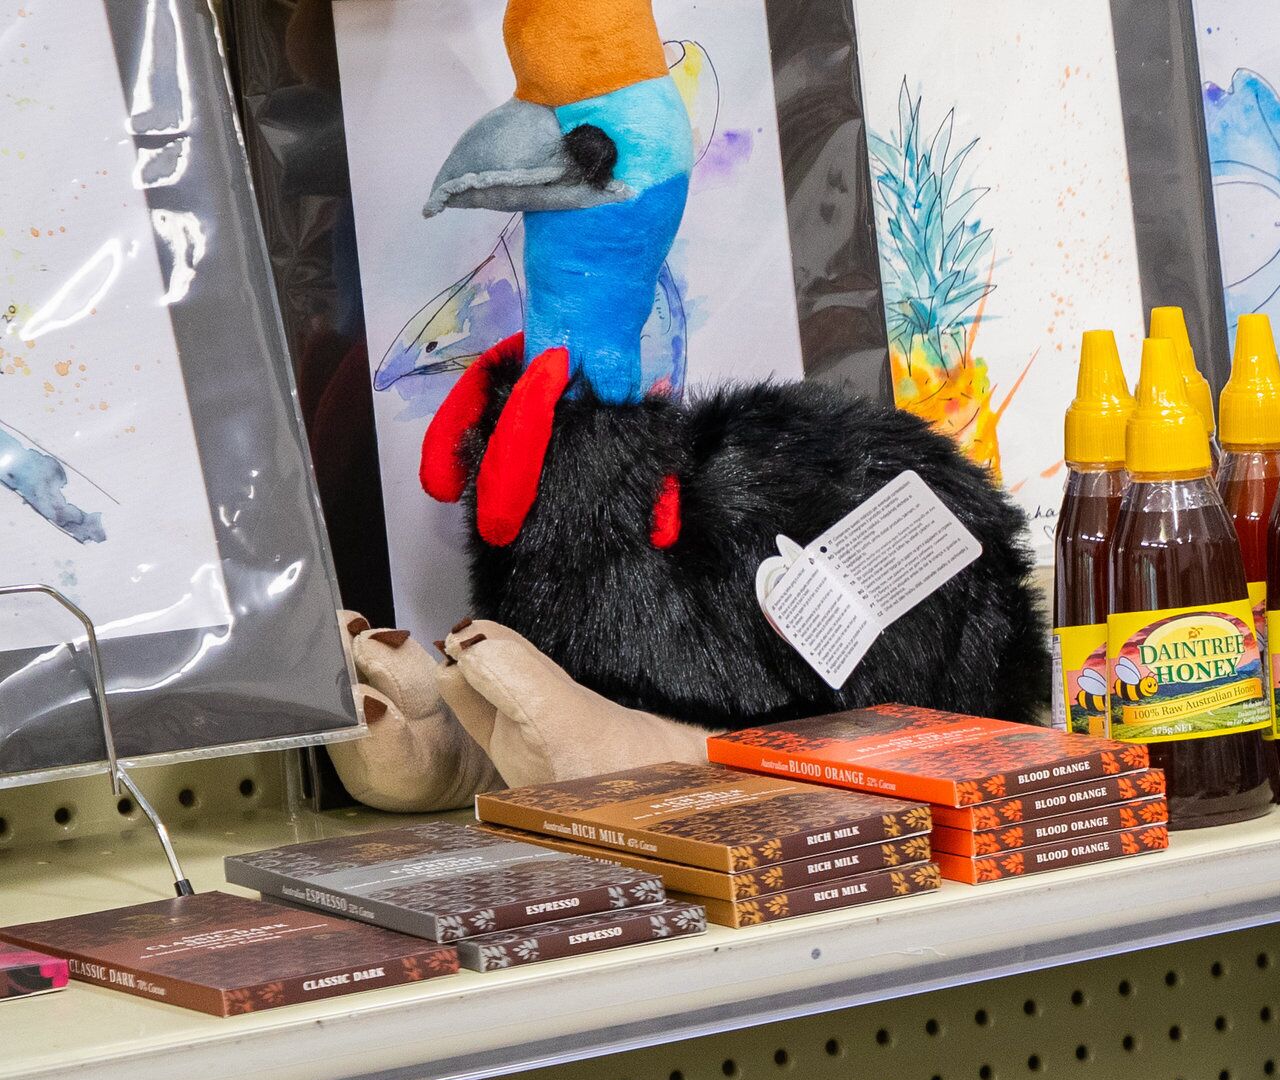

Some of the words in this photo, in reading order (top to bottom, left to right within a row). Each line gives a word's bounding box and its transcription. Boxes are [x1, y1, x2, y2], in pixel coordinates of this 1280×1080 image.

[1140, 634, 1245, 666] DAINTREE
[1156, 657, 1238, 684] HONEY
[1133, 708, 1160, 720] 100%
[1162, 703, 1183, 716] Raw
[1186, 691, 1232, 711] Australian
[1233, 684, 1257, 698] Honey
[760, 758, 788, 771] Australian
[789, 759, 822, 777] BLOOD
[825, 767, 864, 786] ORANGE
[1018, 769, 1050, 784] BLOOD
[1052, 761, 1091, 777] ORANGE
[1035, 795, 1067, 810] BLOOD
[1070, 787, 1108, 803] ORANGE
[572, 822, 595, 840] RICH
[599, 829, 625, 846] MILK
[807, 832, 831, 845] RICH
[834, 826, 860, 840] MILK
[1036, 824, 1068, 838] BLOOD
[1071, 817, 1109, 831] ORANGE
[1036, 849, 1068, 863] BLOOD
[1071, 842, 1110, 857] ORANGE
[807, 861, 831, 874] RICH
[834, 855, 860, 869] MILK
[305, 888, 348, 911] ESPRESSO
[814, 890, 839, 902] RICH
[842, 883, 868, 897] MILK
[526, 898, 580, 915] ESPRESSO
[569, 927, 623, 945] ESPRESSO
[69, 959, 107, 981] CLASSIC
[109, 971, 135, 988] DARK
[303, 973, 350, 991] CLASSIC
[353, 967, 385, 983] DARK
